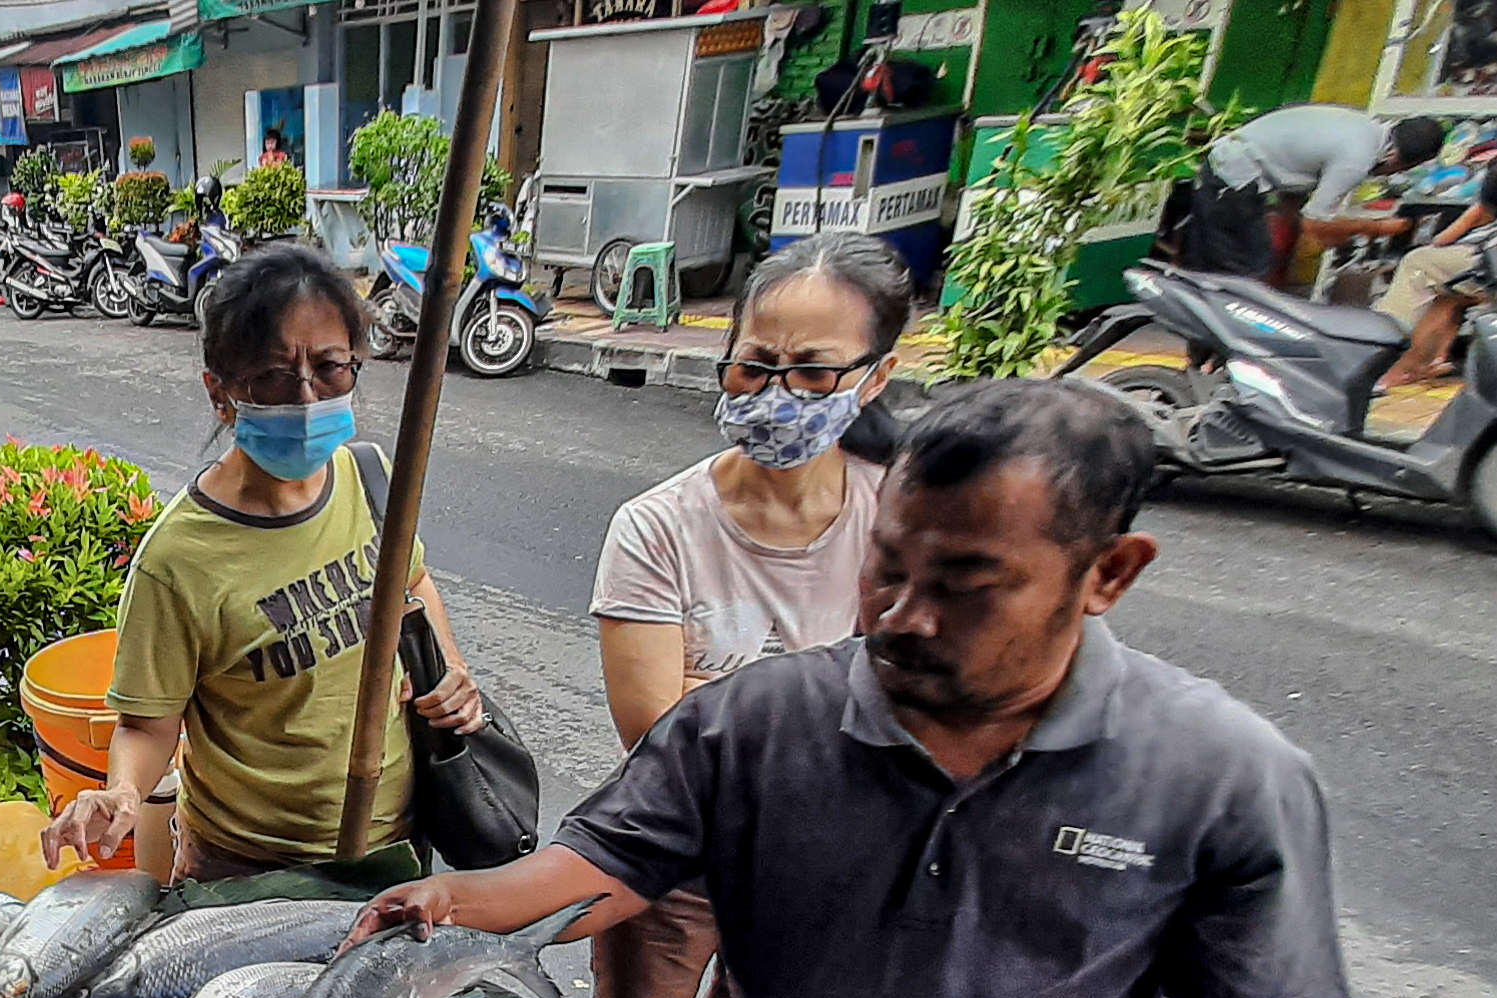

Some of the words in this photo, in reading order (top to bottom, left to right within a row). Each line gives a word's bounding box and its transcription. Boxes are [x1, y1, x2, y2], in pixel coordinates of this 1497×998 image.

[782, 201, 862, 226] PERTAMAX
[877, 185, 942, 223] PERTAMAX
[256, 550, 372, 634] WHERE
[246, 632, 316, 682] YOU
